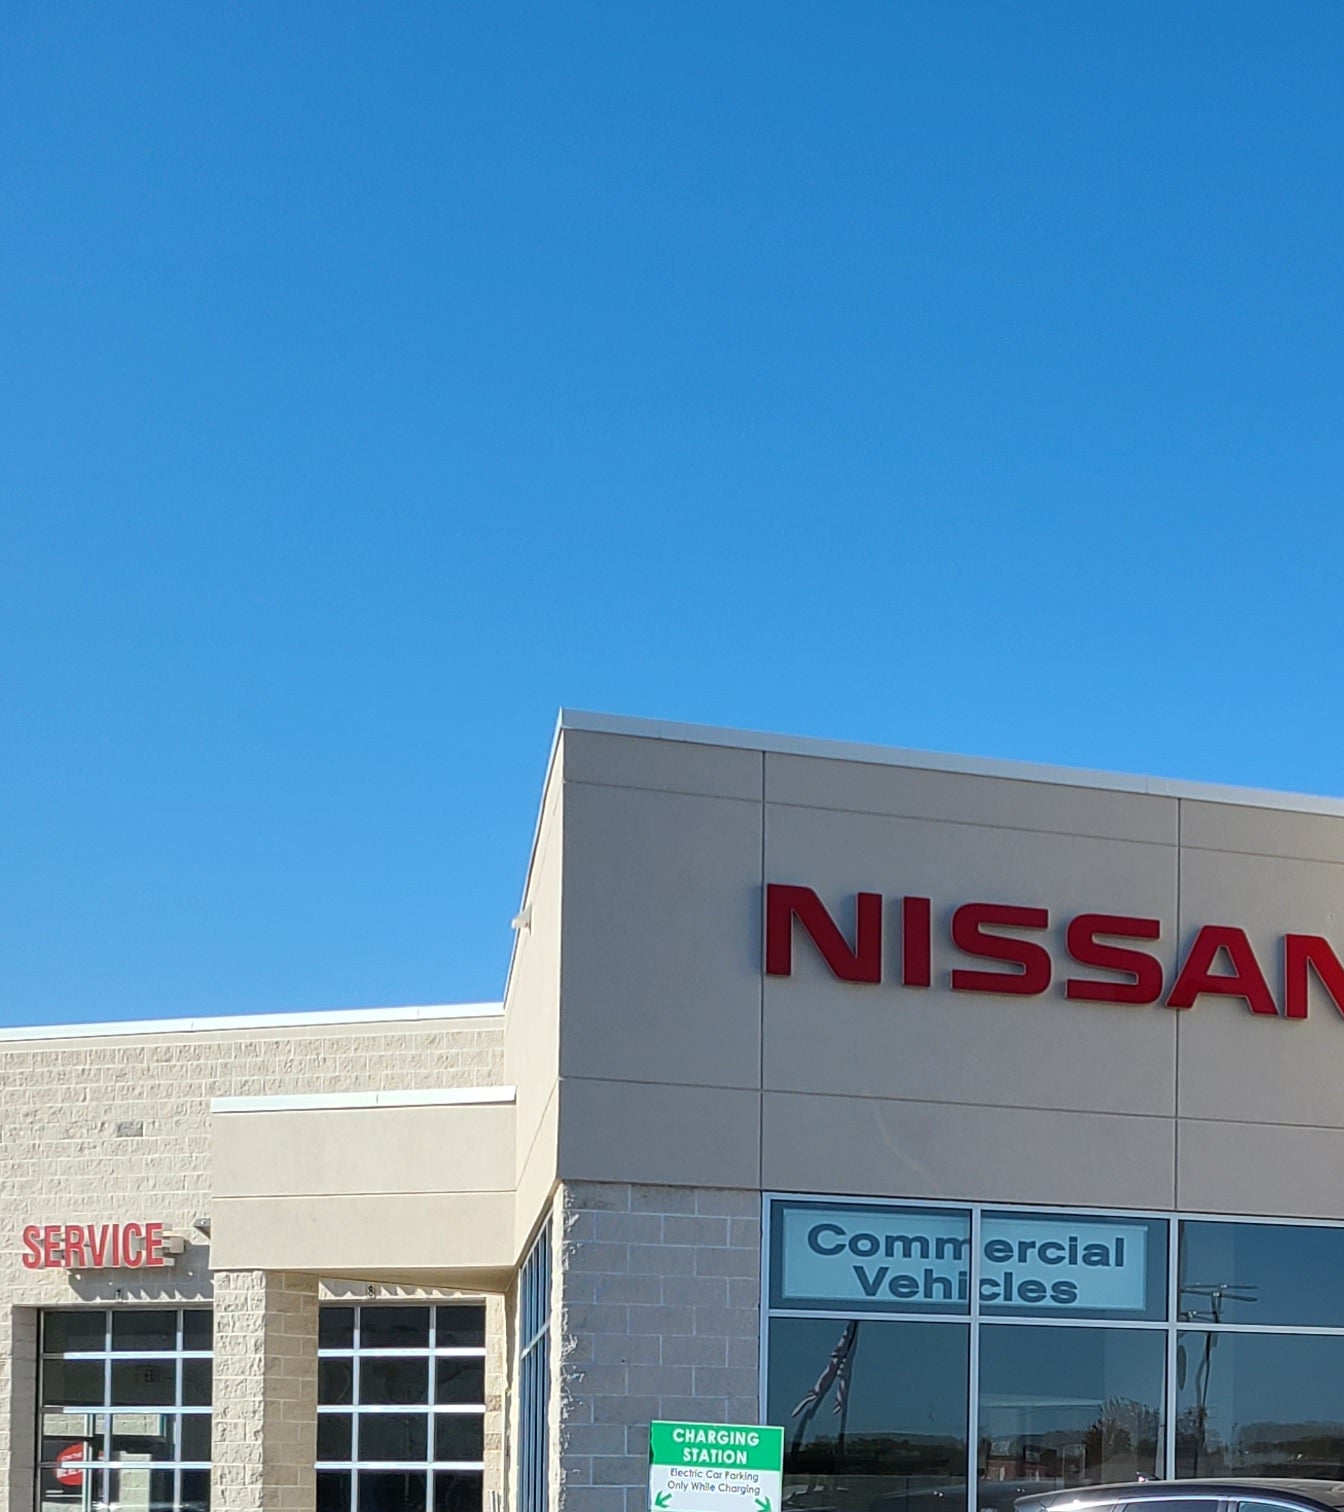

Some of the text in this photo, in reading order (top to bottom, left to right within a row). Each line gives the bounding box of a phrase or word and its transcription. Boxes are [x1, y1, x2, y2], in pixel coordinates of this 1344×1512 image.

[21, 1221, 165, 1269] SERVICE
[807, 1223, 1126, 1268] Commercial
[852, 1265, 1079, 1305] Vehicles
[672, 1428, 760, 1447] CHARGING
[682, 1447, 748, 1465] STATION
[670, 1467, 759, 1484] Electric Car Parking
[667, 1480, 761, 1497] Only While Charging
